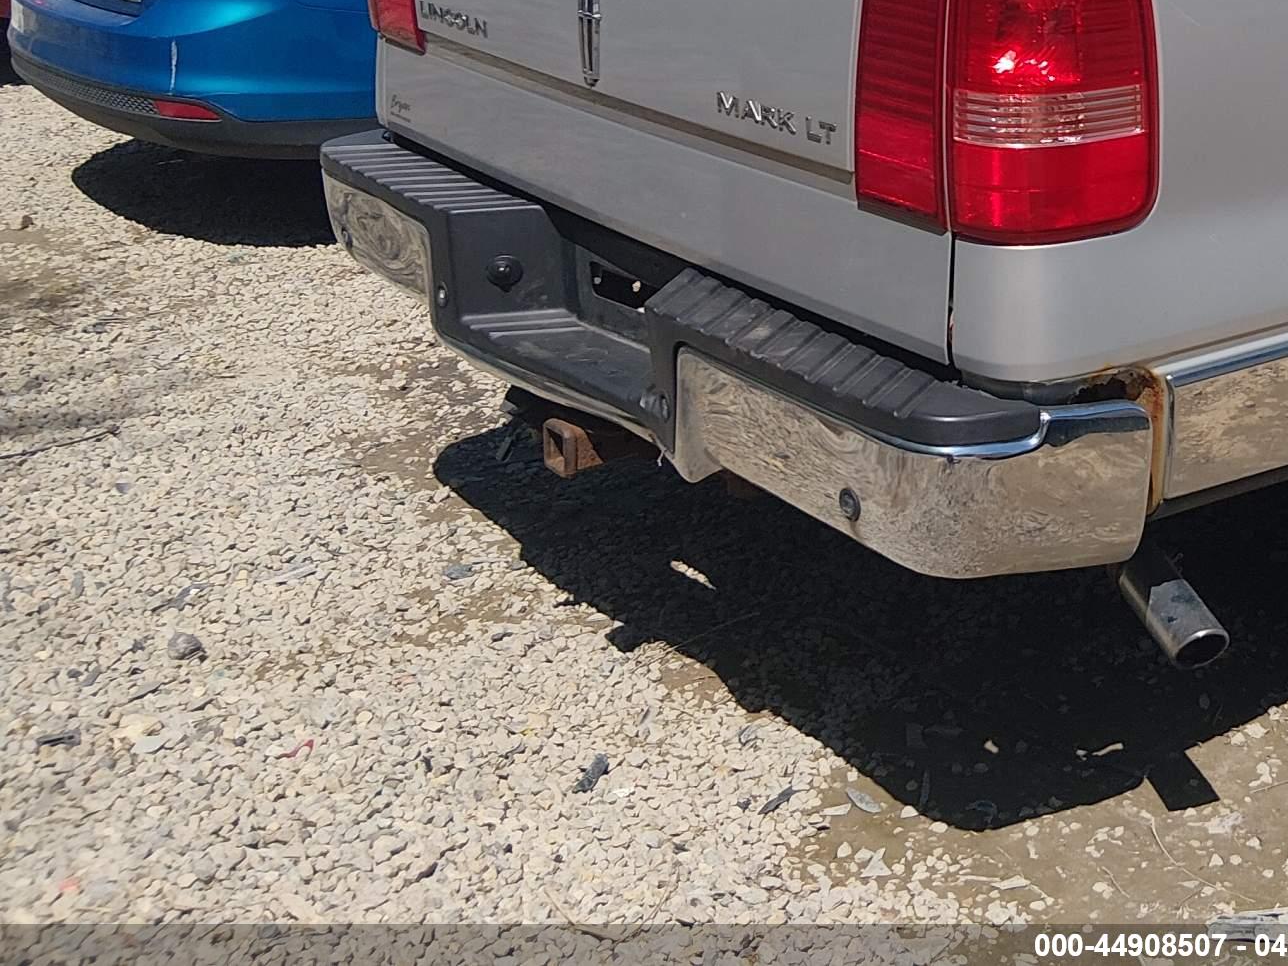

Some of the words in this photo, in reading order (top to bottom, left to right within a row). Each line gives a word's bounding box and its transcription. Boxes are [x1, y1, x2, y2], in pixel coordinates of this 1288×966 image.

[419, 0, 488, 39] LINCOLN
[716, 90, 797, 136] MARK
[805, 115, 838, 145] LT
